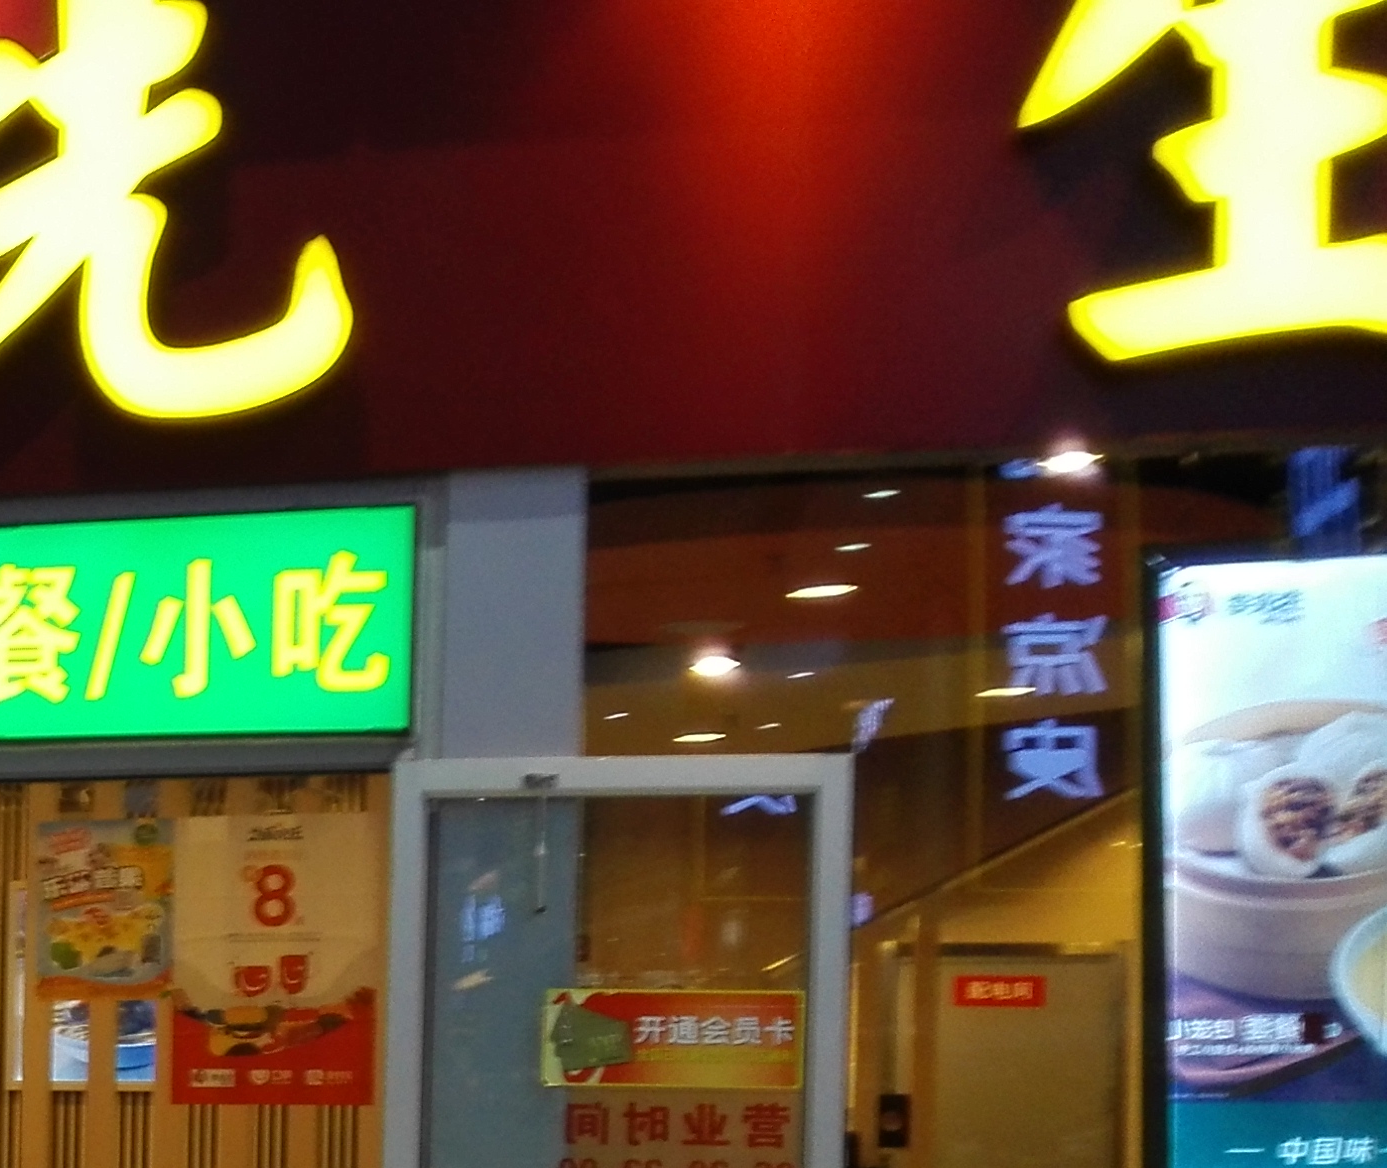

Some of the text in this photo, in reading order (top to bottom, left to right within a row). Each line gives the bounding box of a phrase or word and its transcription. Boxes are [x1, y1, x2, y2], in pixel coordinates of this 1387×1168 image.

[254, 864, 296, 927] 8
[633, 1015, 796, 1045] 开通会员卡
